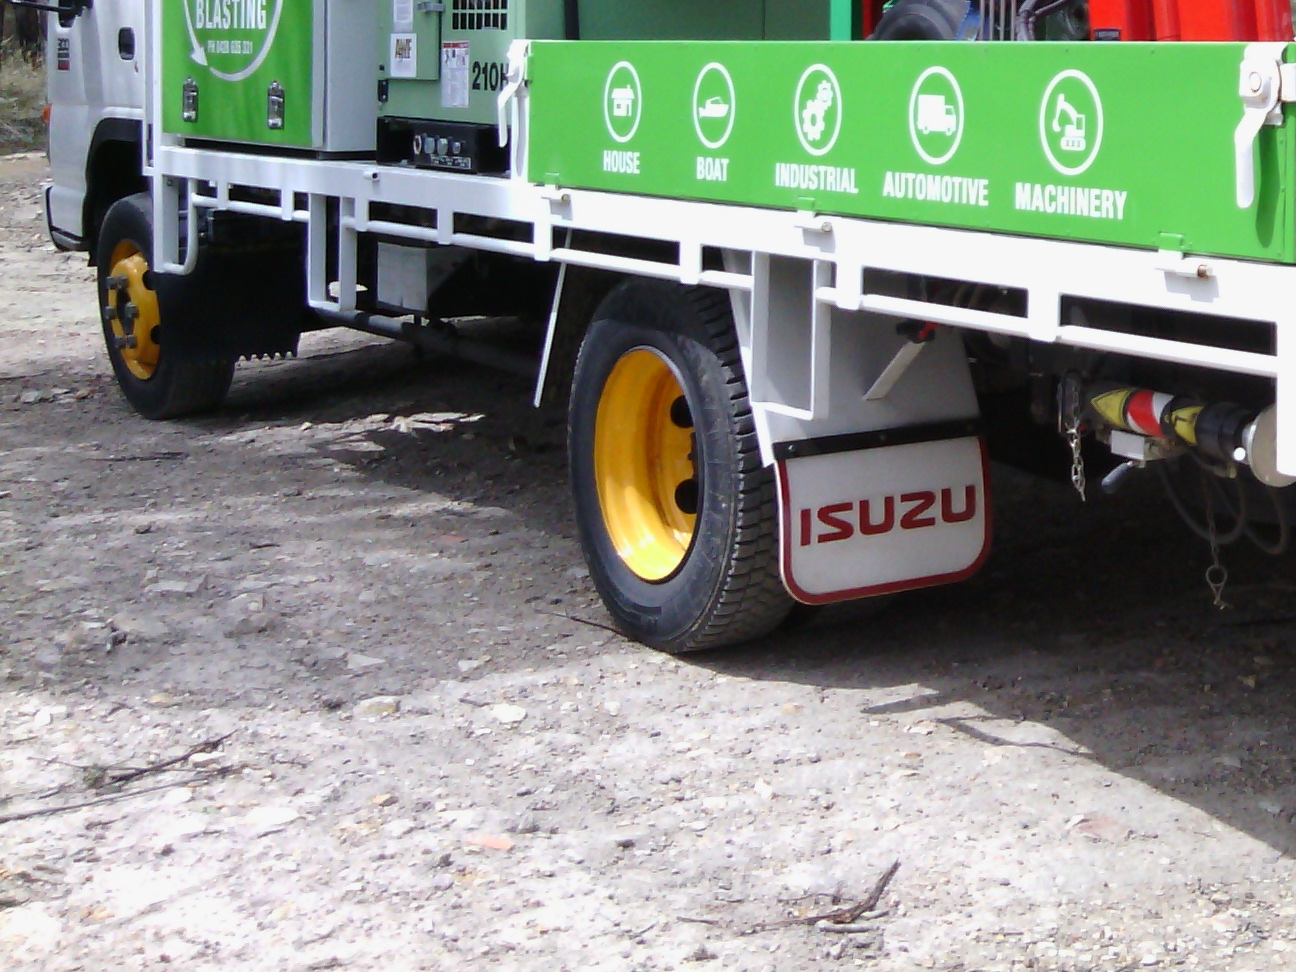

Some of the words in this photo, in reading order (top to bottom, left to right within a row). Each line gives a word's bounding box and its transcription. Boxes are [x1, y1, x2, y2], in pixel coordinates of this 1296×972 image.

[603, 150, 641, 175] HOUSE
[696, 156, 730, 182] BOAT
[774, 162, 859, 194] INDUSTRIAL
[882, 171, 989, 207] AUTOMOTIVE
[1015, 182, 1128, 220] MACHINERY
[800, 484, 976, 547] ISUZU
